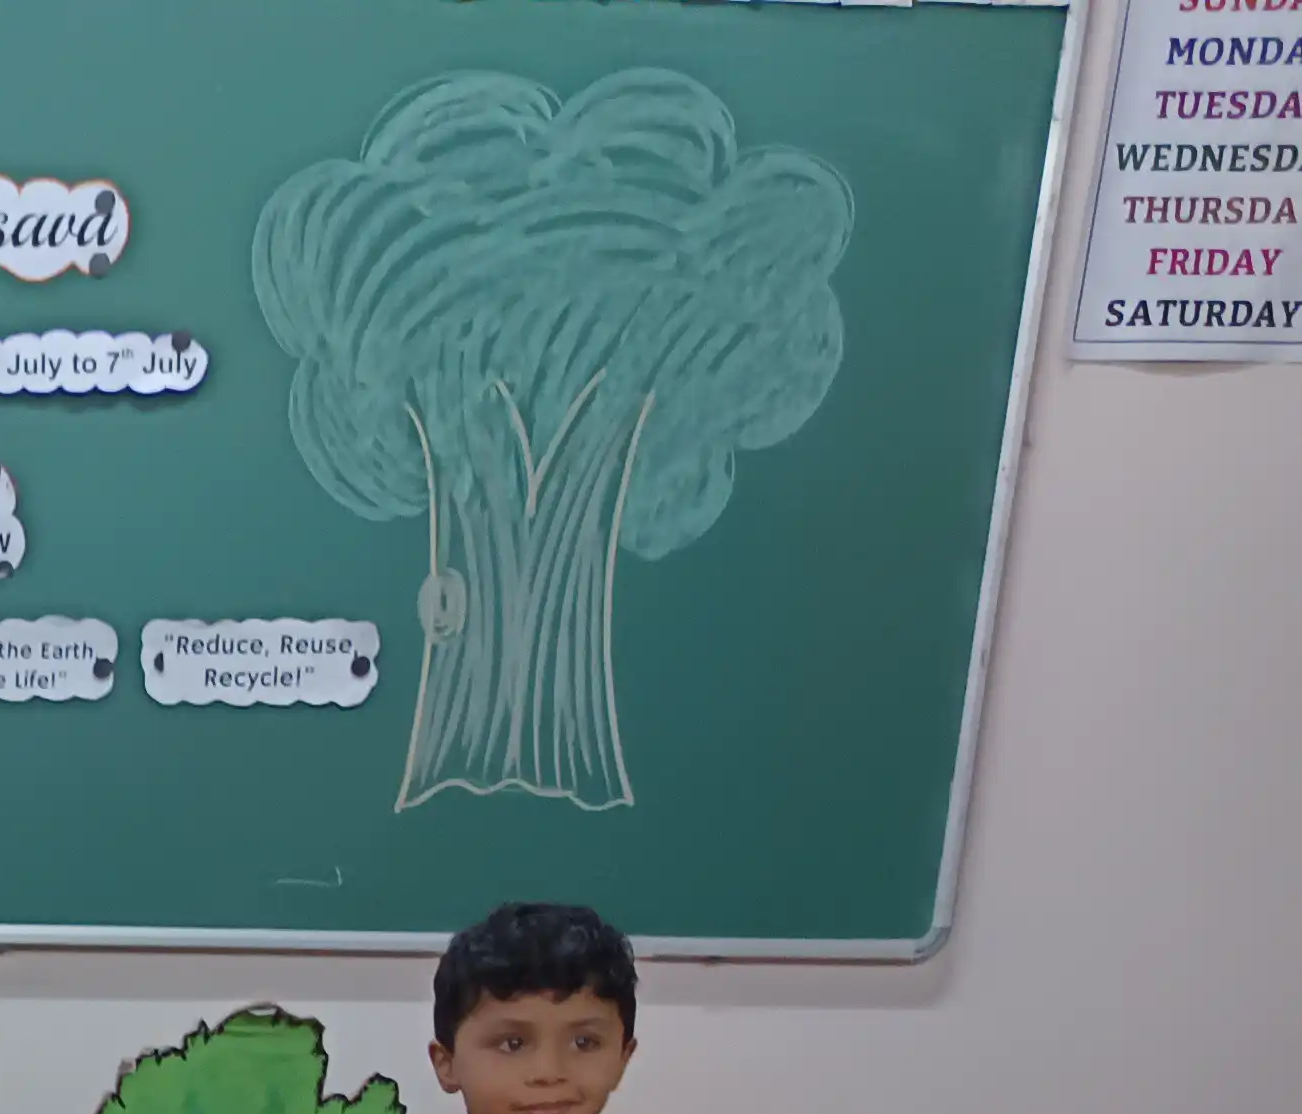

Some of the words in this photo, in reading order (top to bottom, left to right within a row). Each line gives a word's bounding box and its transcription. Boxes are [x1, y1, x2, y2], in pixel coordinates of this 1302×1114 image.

[1166, 37, 1302, 66] MONDA
[1156, 90, 1302, 119] TUESDA
[1116, 143, 1302, 172] WEDNESD
[1123, 196, 1298, 225] THURSDA
[1146, 247, 1285, 276] FRIDAY
[1104, 299, 1302, 328] SATURDAY
[6, 352, 62, 380] July
[72, 353, 97, 375] to
[107, 348, 134, 374] 7th
[142, 350, 197, 380] July
[164, 633, 270, 658] "Reduce,
[204, 665, 315, 692] Recycle!"
